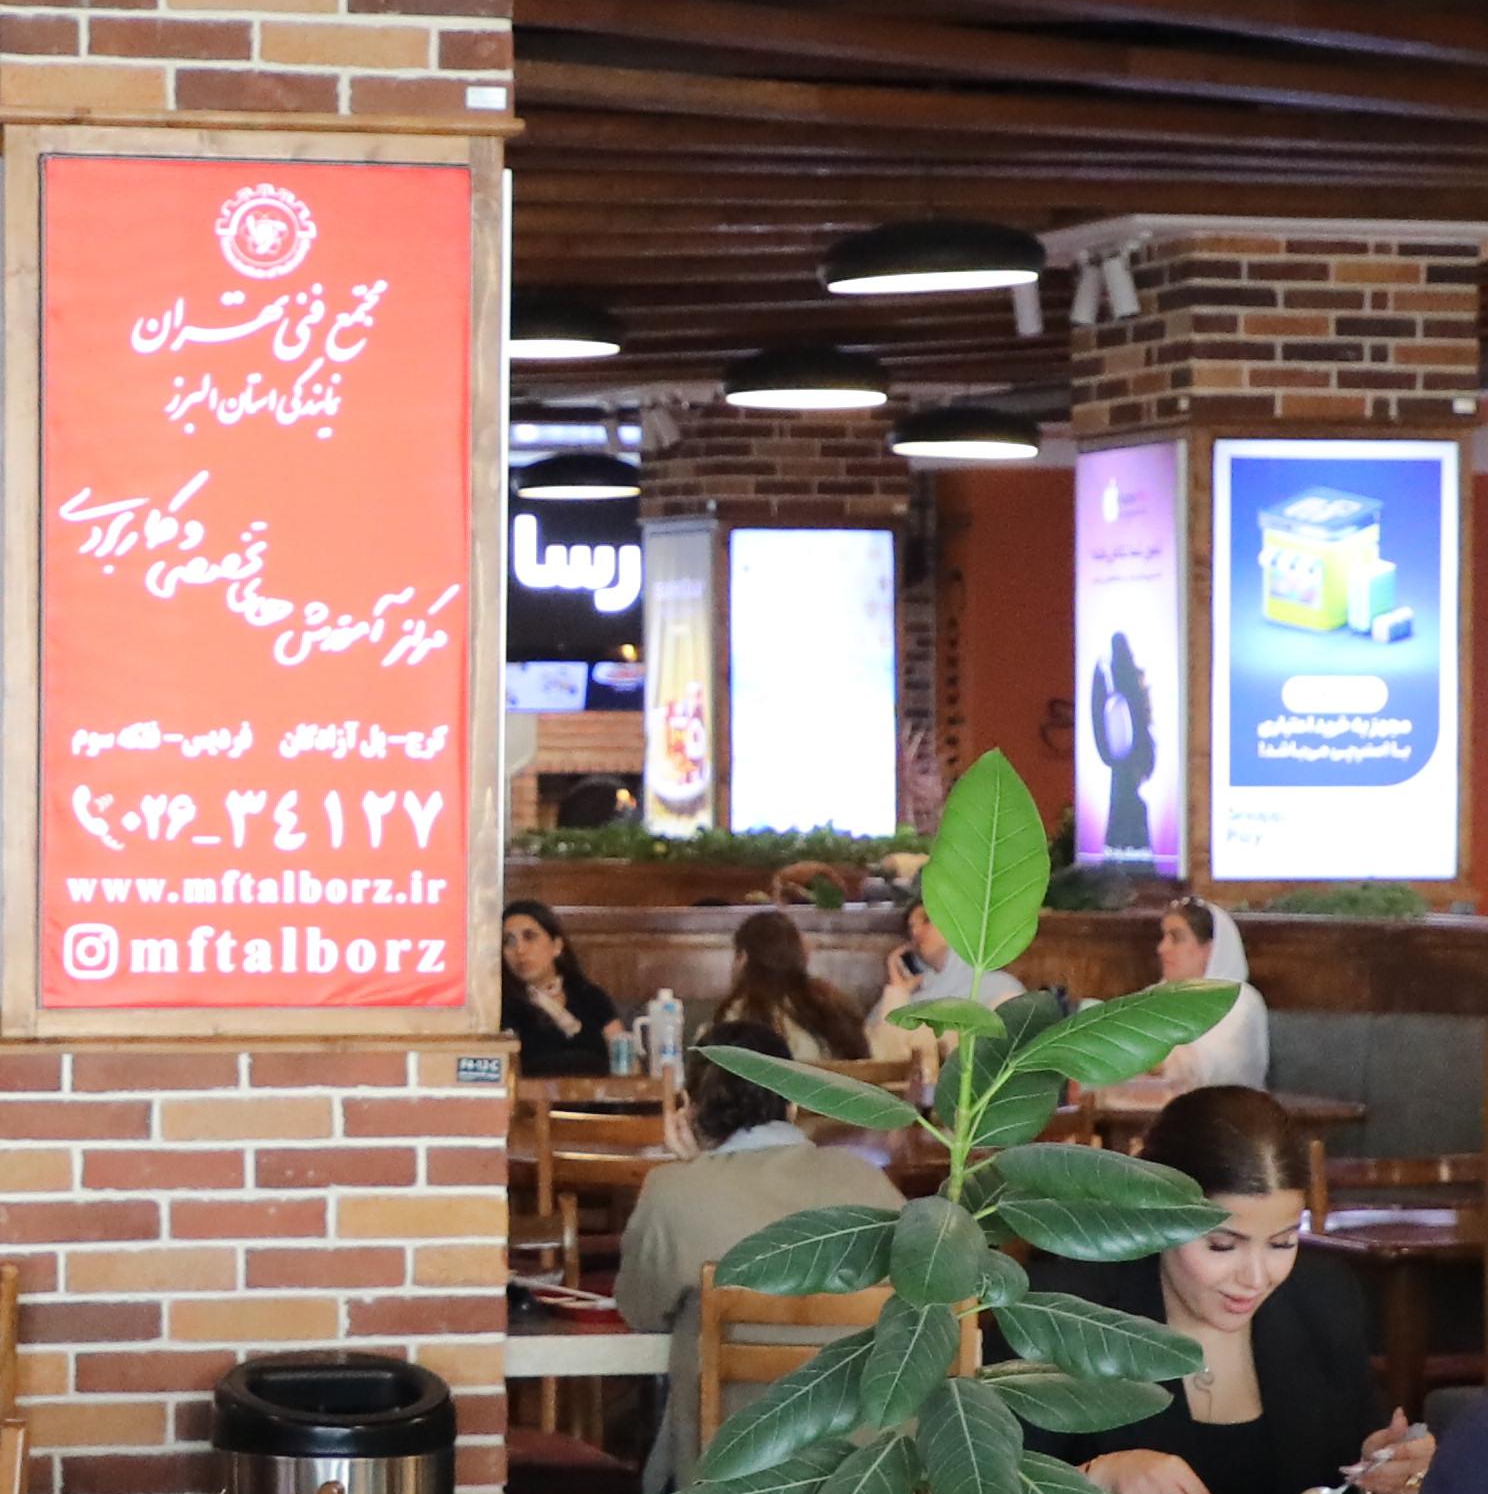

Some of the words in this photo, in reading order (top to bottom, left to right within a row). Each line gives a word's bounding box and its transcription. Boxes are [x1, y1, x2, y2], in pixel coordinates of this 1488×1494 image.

[130, 290, 290, 353] تهران
[273, 283, 325, 361] فنی
[325, 280, 388, 362] مجتمع
[164, 373, 218, 434] البرز
[382, 584, 460, 667] مرکز
[66, 870, 448, 905] www.mftalborz.ir
[129, 925, 447, 974] mftalborz
